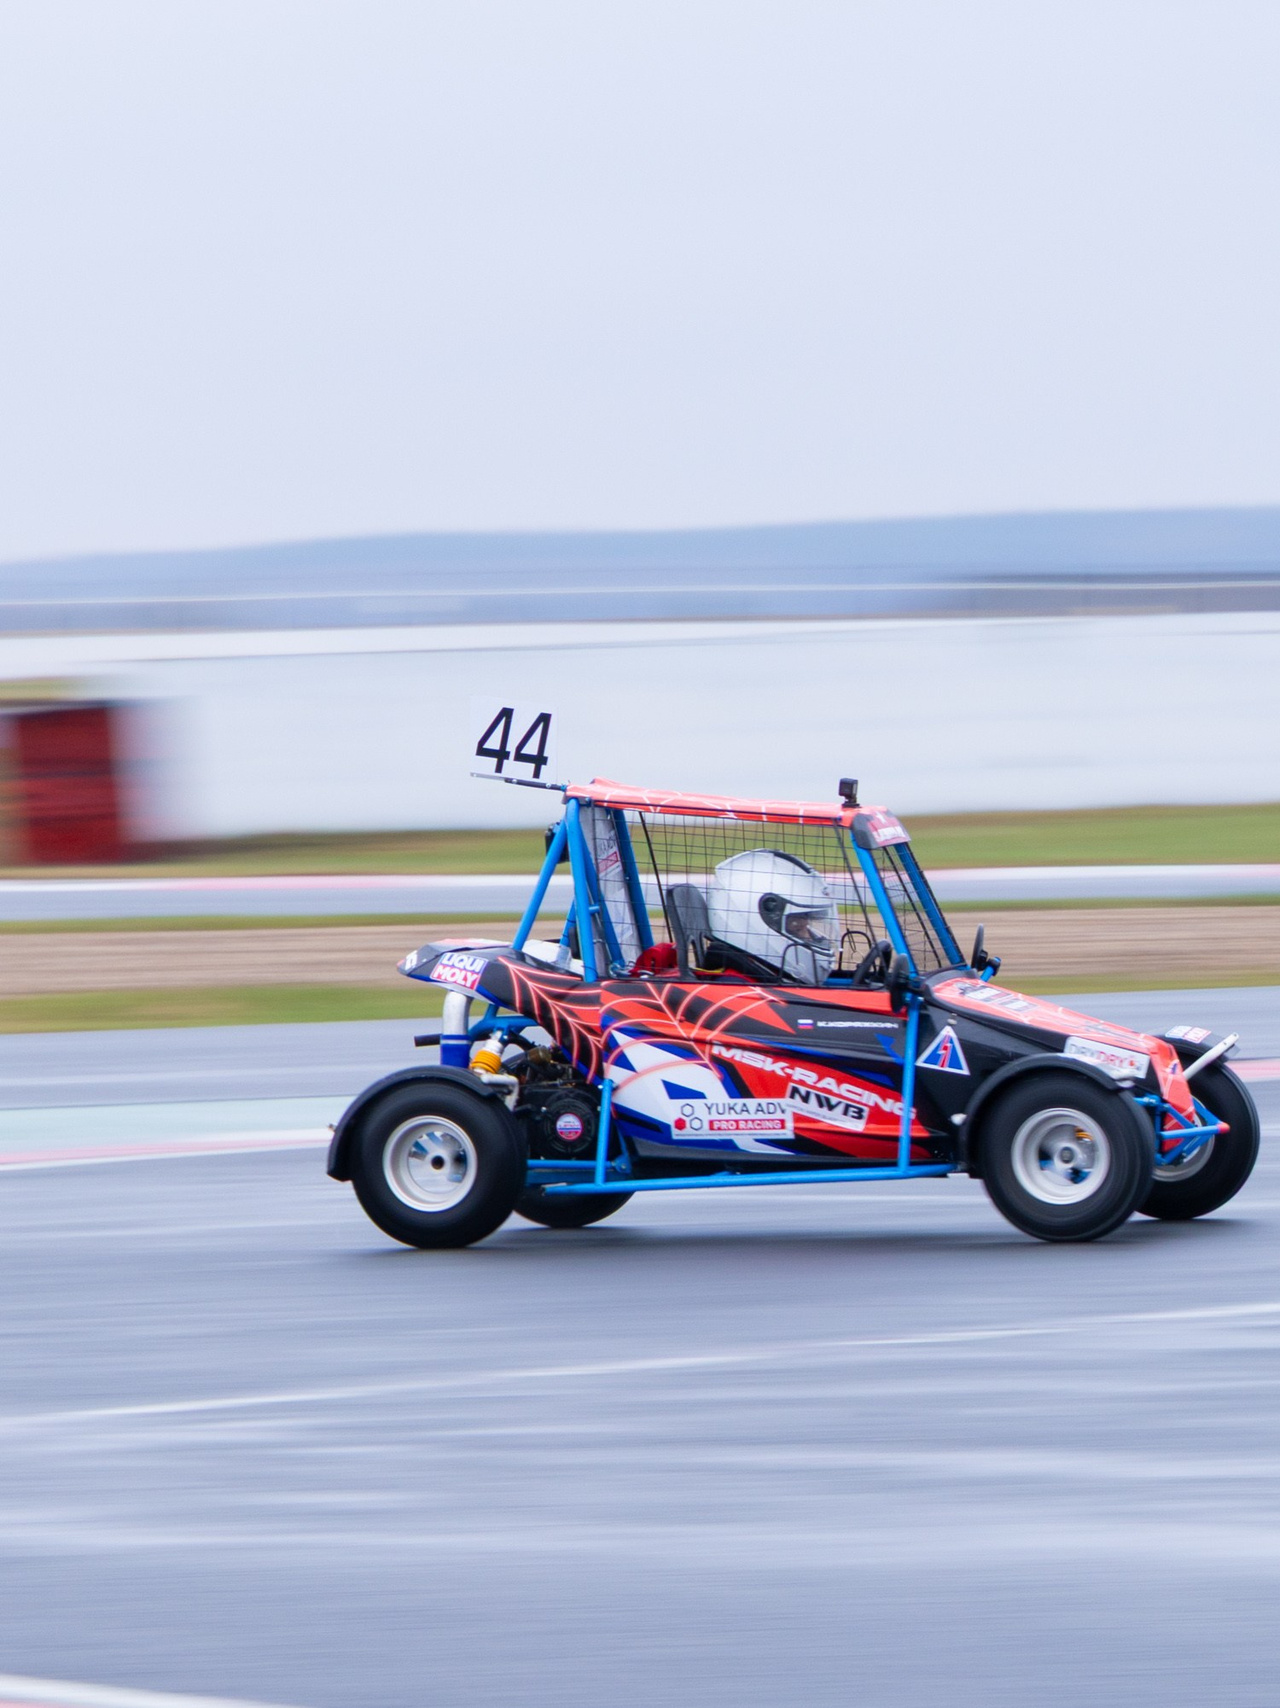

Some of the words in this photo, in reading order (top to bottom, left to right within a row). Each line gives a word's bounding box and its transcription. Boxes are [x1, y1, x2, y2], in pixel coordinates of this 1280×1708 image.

[475, 706, 552, 779] 44
[441, 953, 485, 973] LIQUI
[432, 964, 478, 988] MOLY
[704, 1102, 751, 1115] YUKA
[789, 1085, 866, 1120] NWB
[713, 1120, 737, 1130] PRO
[738, 1120, 782, 1130] RACING
